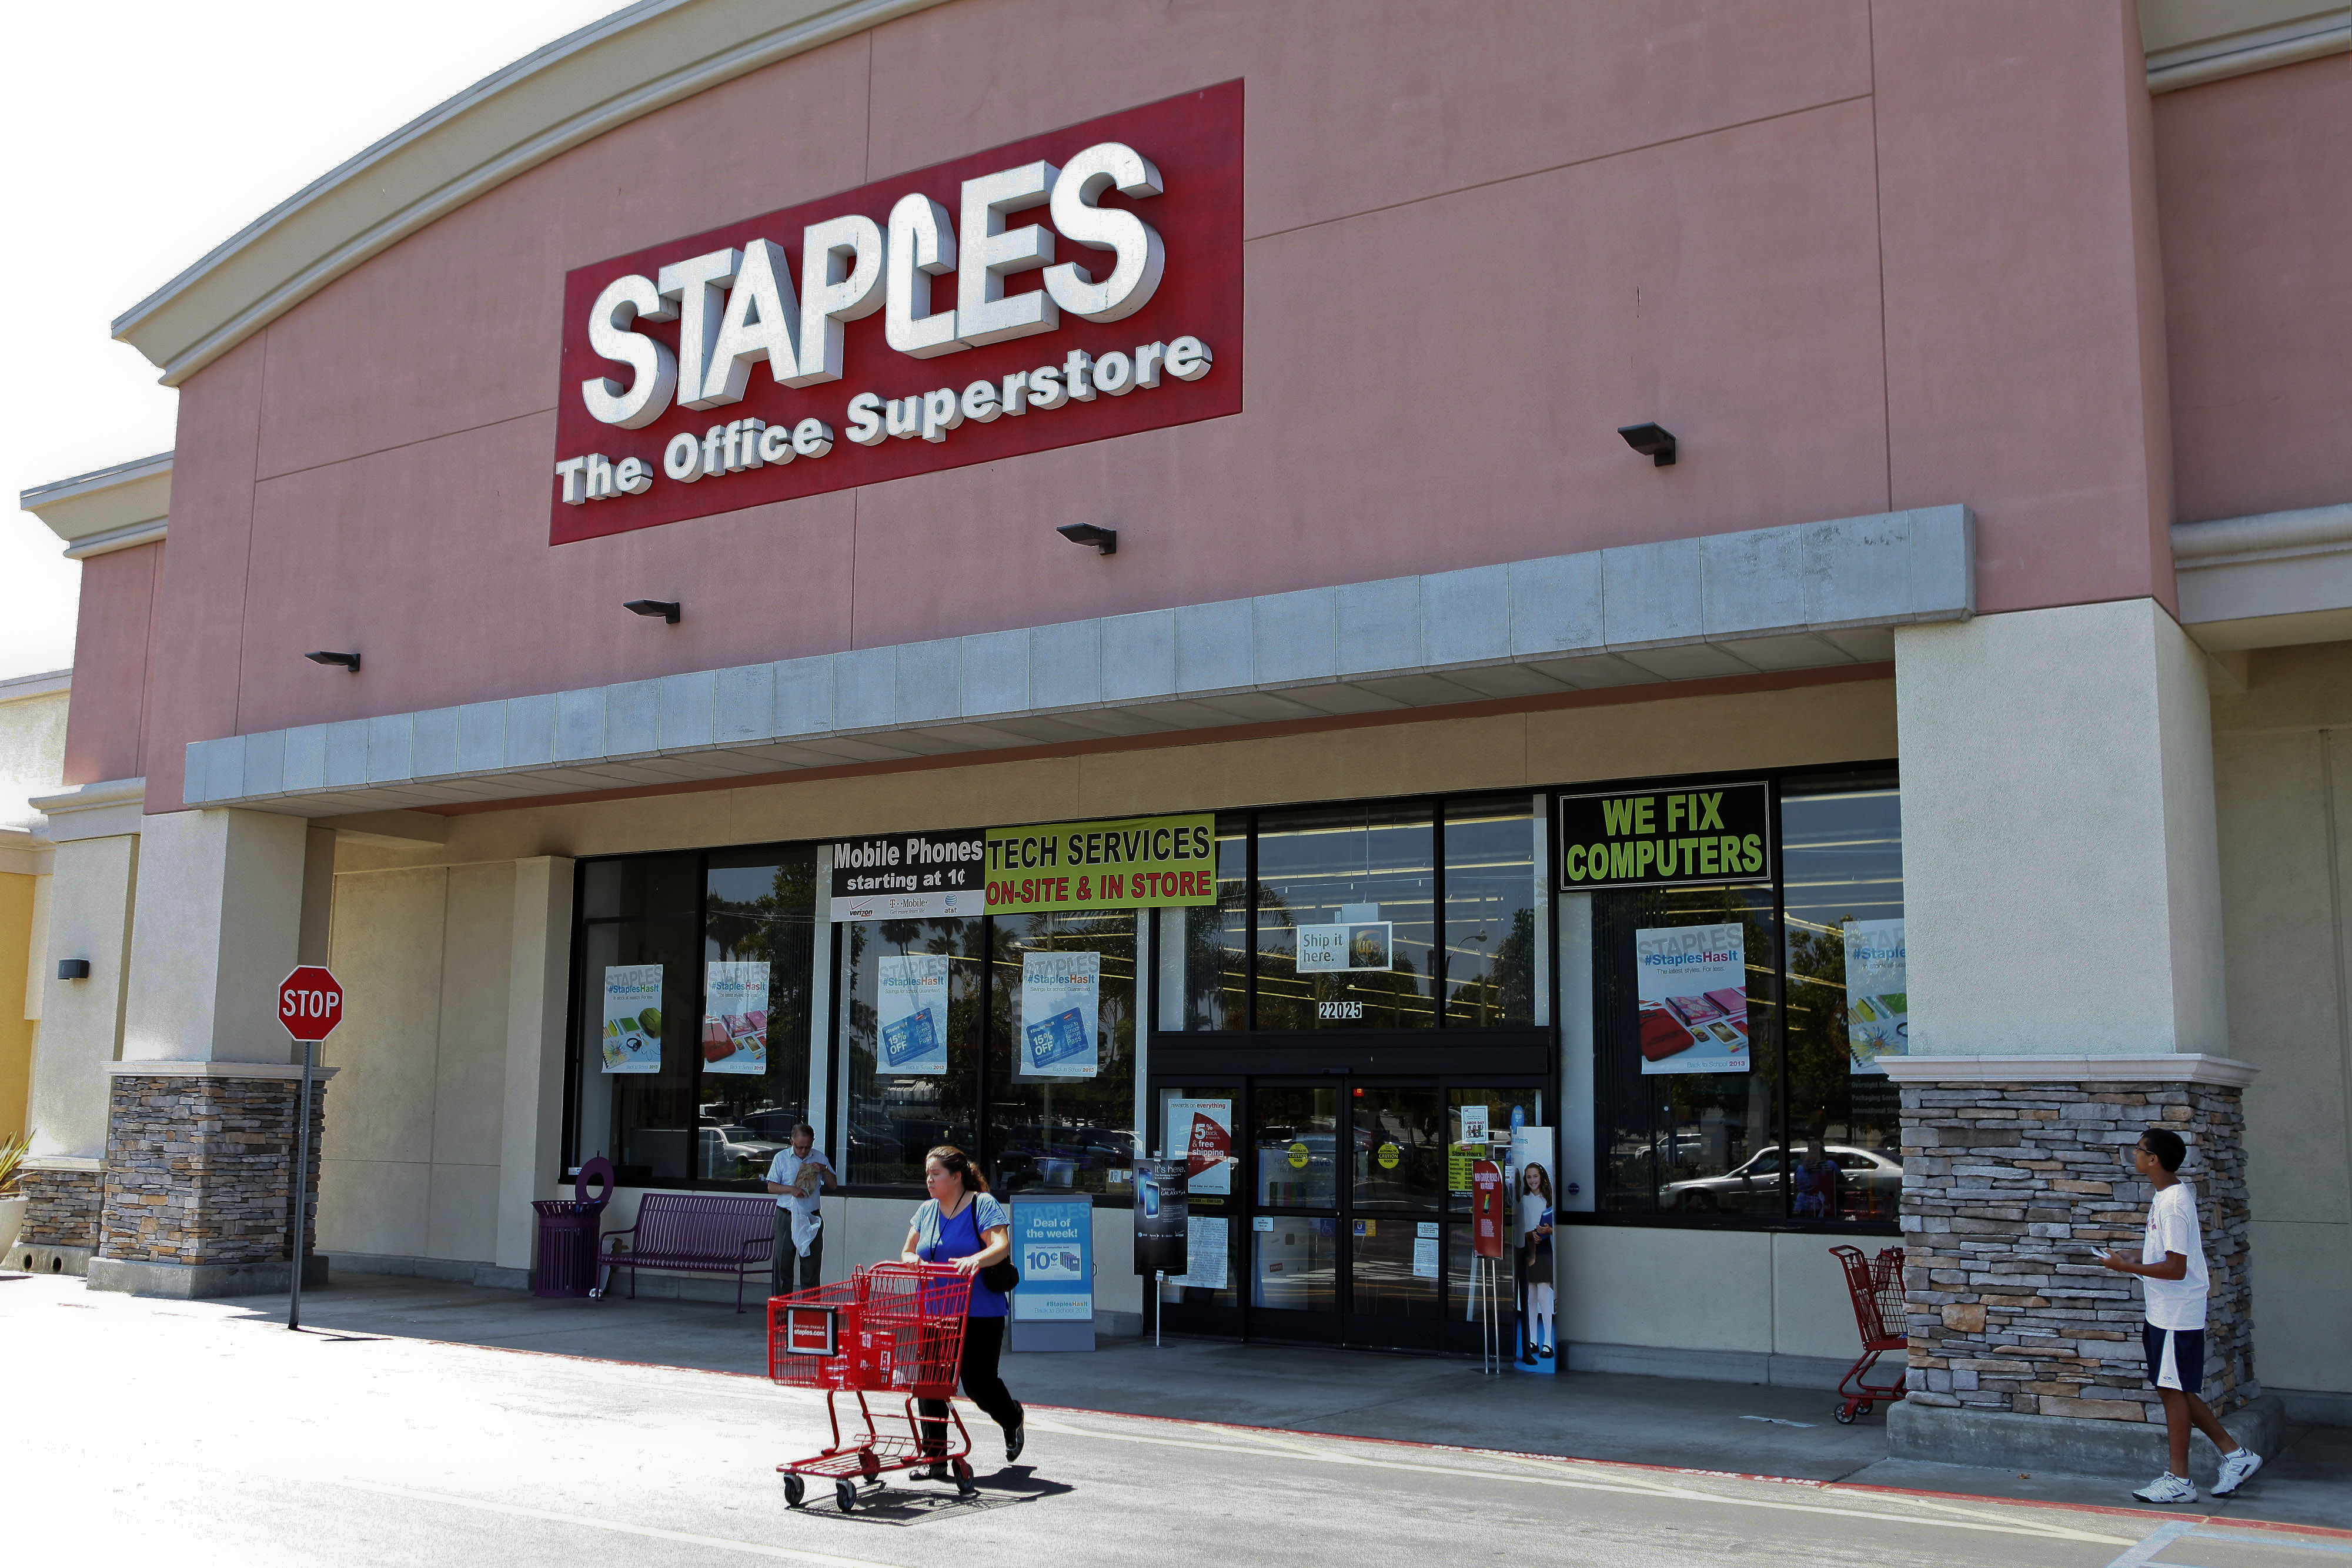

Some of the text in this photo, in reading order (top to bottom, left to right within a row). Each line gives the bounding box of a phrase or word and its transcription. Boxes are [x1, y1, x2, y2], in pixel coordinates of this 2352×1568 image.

[582, 141, 1165, 430] STAPLES
[282, 402, 339, 430] STOP
[556, 335, 1212, 505] The Office Superstore
[1602, 792, 1725, 835] WE FIX
[834, 838, 983, 869] Mobile Phones
[987, 825, 1211, 871] TECH SERVICES
[1567, 834, 1762, 881] COMPUTERS
[847, 868, 965, 890] starting at 1¢
[985, 871, 1212, 906] ON-SITE & IN STORE
[1303, 932, 1343, 950] Ship it
[1638, 925, 1742, 964] STAPLES
[1303, 950, 1335, 962] here.
[1645, 950, 1738, 966] #StaplesHasIt
[1853, 946, 1905, 960] #Staple
[1024, 954, 1099, 980] STAPLES
[606, 966, 662, 991] STAPLES
[712, 982, 766, 991] #StaplesHasIt
[883, 977, 944, 988] #StaplesHasIt
[1028, 974, 1095, 985] #StaplesHasIt
[609, 984, 659, 994] #StaplesHasIt
[1320, 1002, 1361, 1018] 22025
[888, 1031, 906, 1045] 15%
[918, 1035, 933, 1044] Pass
[1033, 1031, 1053, 1046] 15%
[1067, 1036, 1082, 1045] Pass
[890, 1041, 907, 1054] OFF
[1035, 1041, 1054, 1055] OFF
[1194, 1123, 1212, 1139] 5%
[1192, 1148, 1224, 1157] shipping
[1155, 1164, 1186, 1174] It's here.
[1033, 1218, 1071, 1227] Deal of
[1026, 1229, 1078, 1238] the week!
[1026, 1252, 1058, 1270] 10¢
